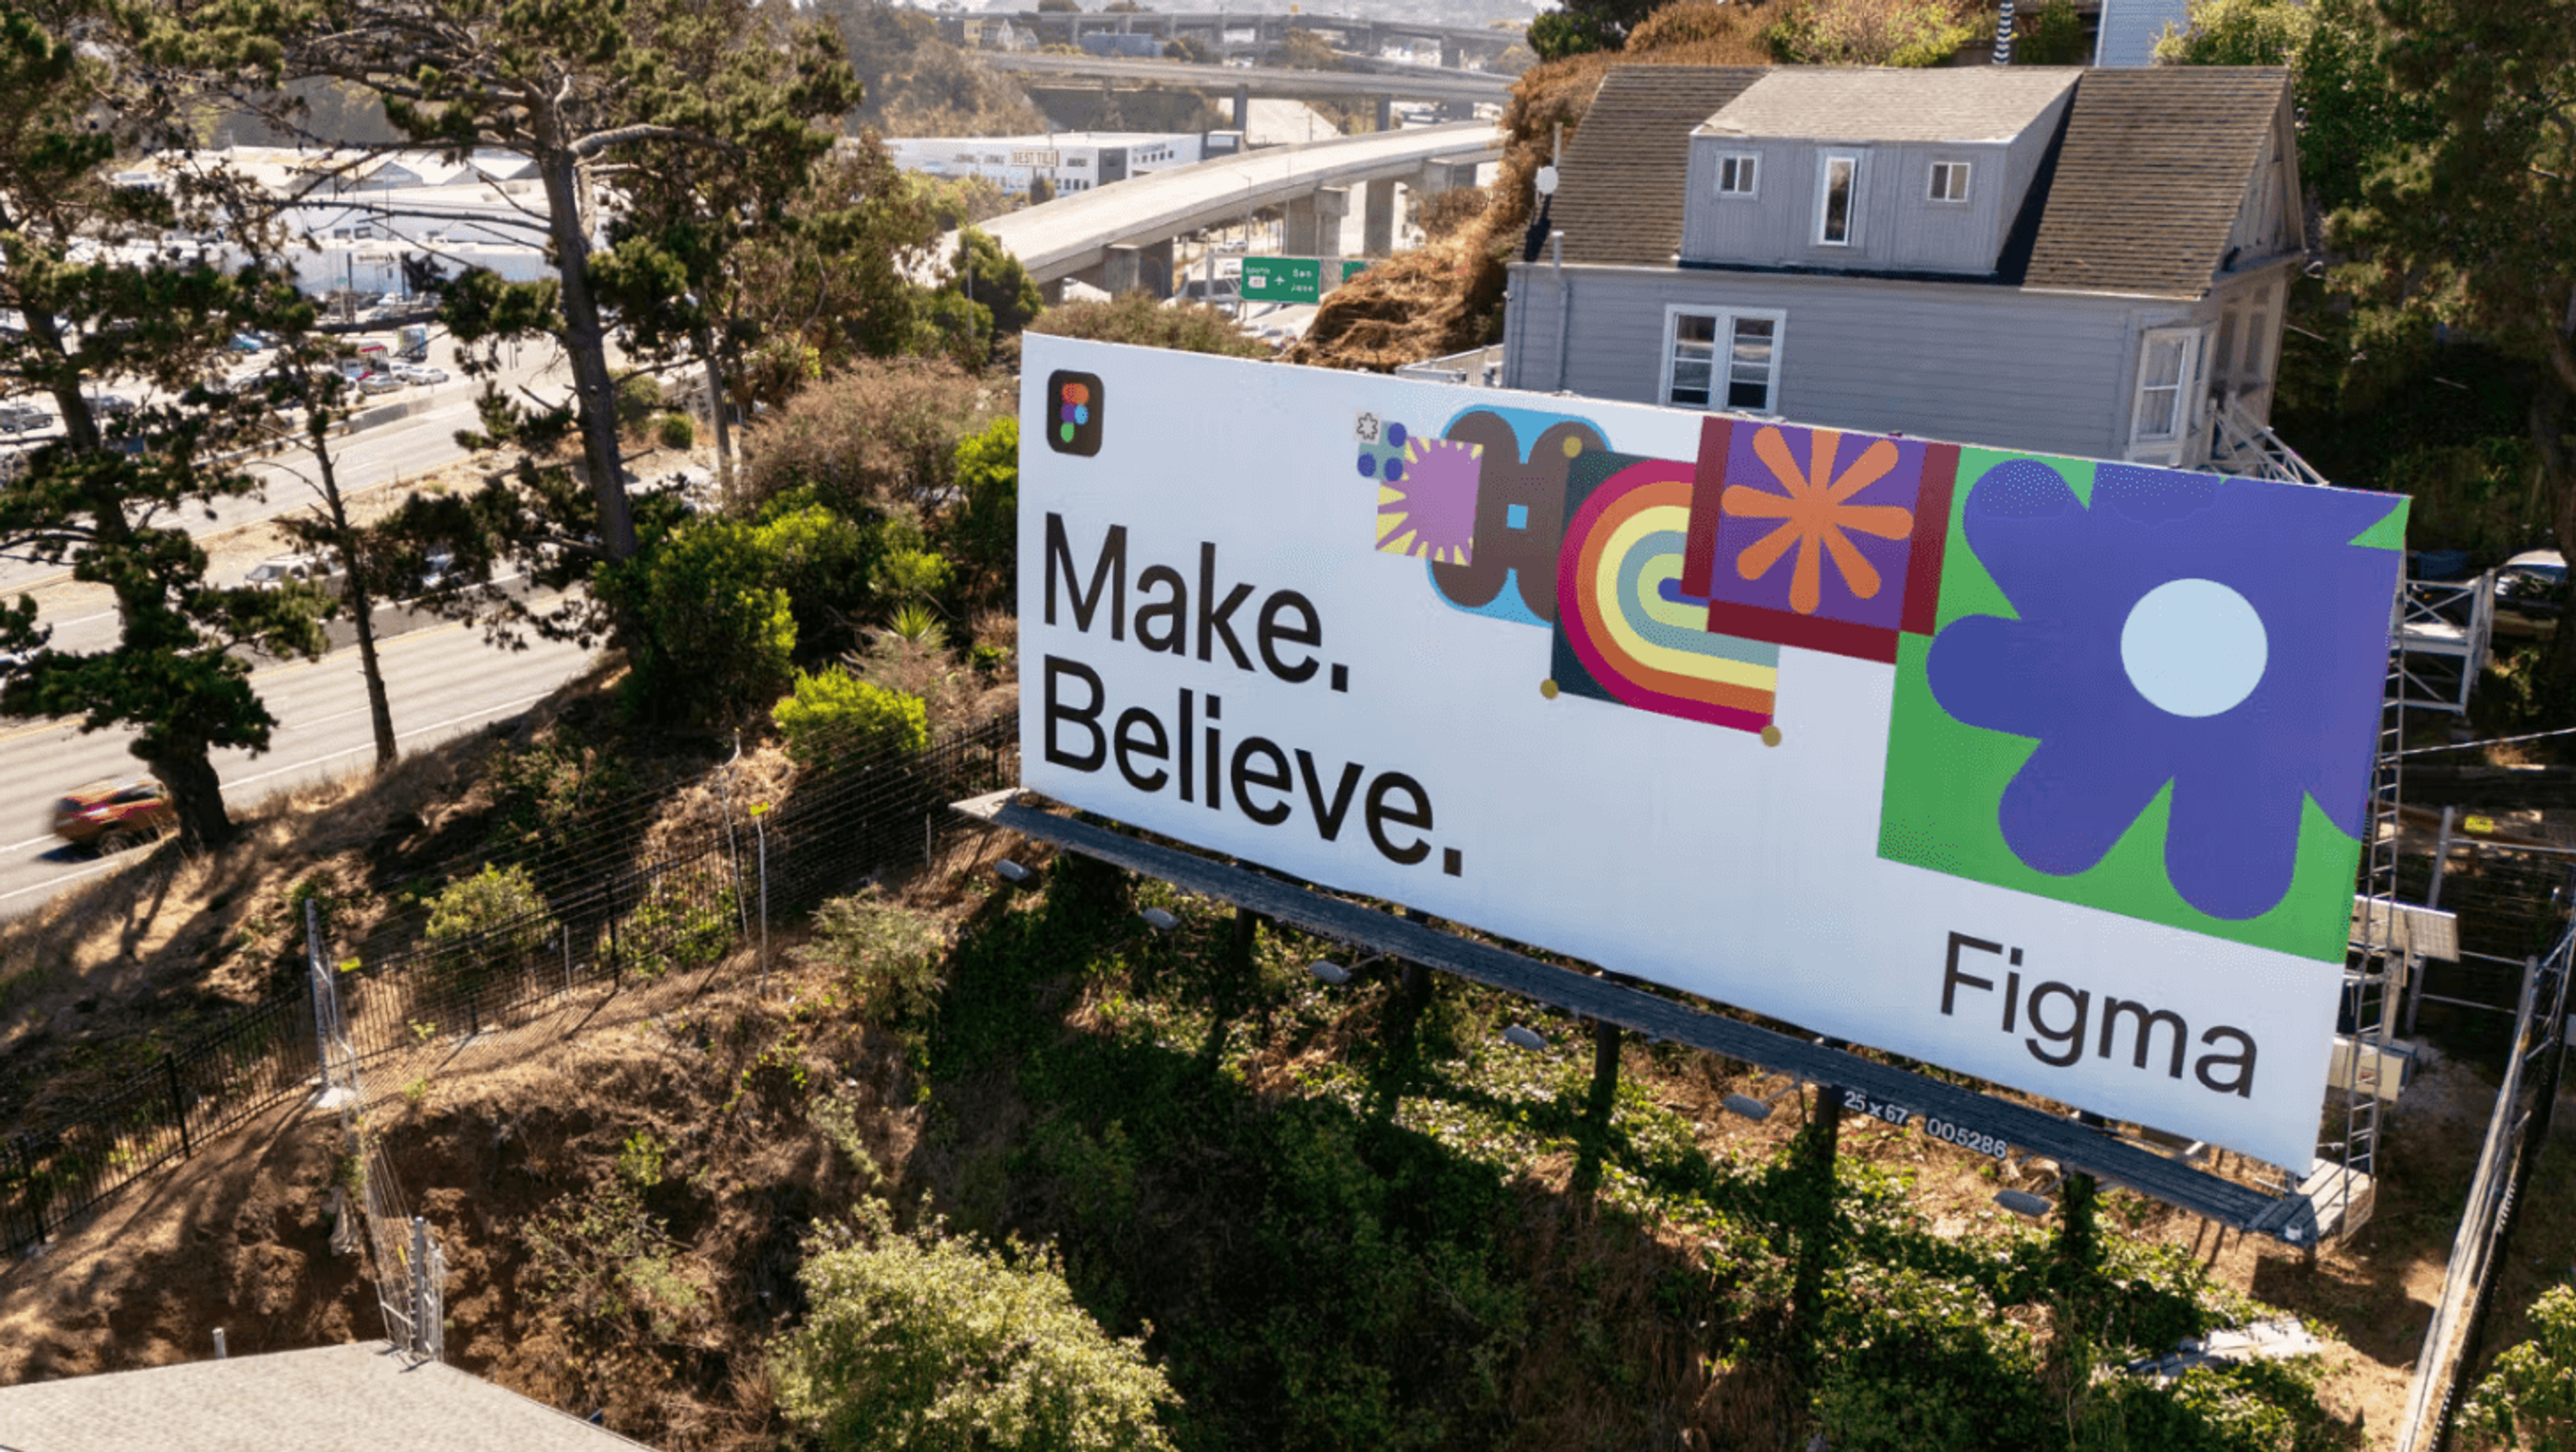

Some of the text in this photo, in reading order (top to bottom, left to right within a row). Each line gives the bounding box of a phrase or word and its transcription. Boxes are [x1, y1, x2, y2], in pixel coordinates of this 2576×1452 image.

[1013, 151, 1034, 162] BEST
[1291, 283, 1314, 293] Jose
[1292, 267, 1313, 278] San
[1044, 512, 1348, 692] Make.
[1044, 654, 1462, 877] Believe.
[1941, 931, 2257, 1098] Figma
[1844, 1090, 1866, 1112] 25
[1884, 1103, 1909, 1125] 67
[1927, 1117, 2008, 1159] 005286
